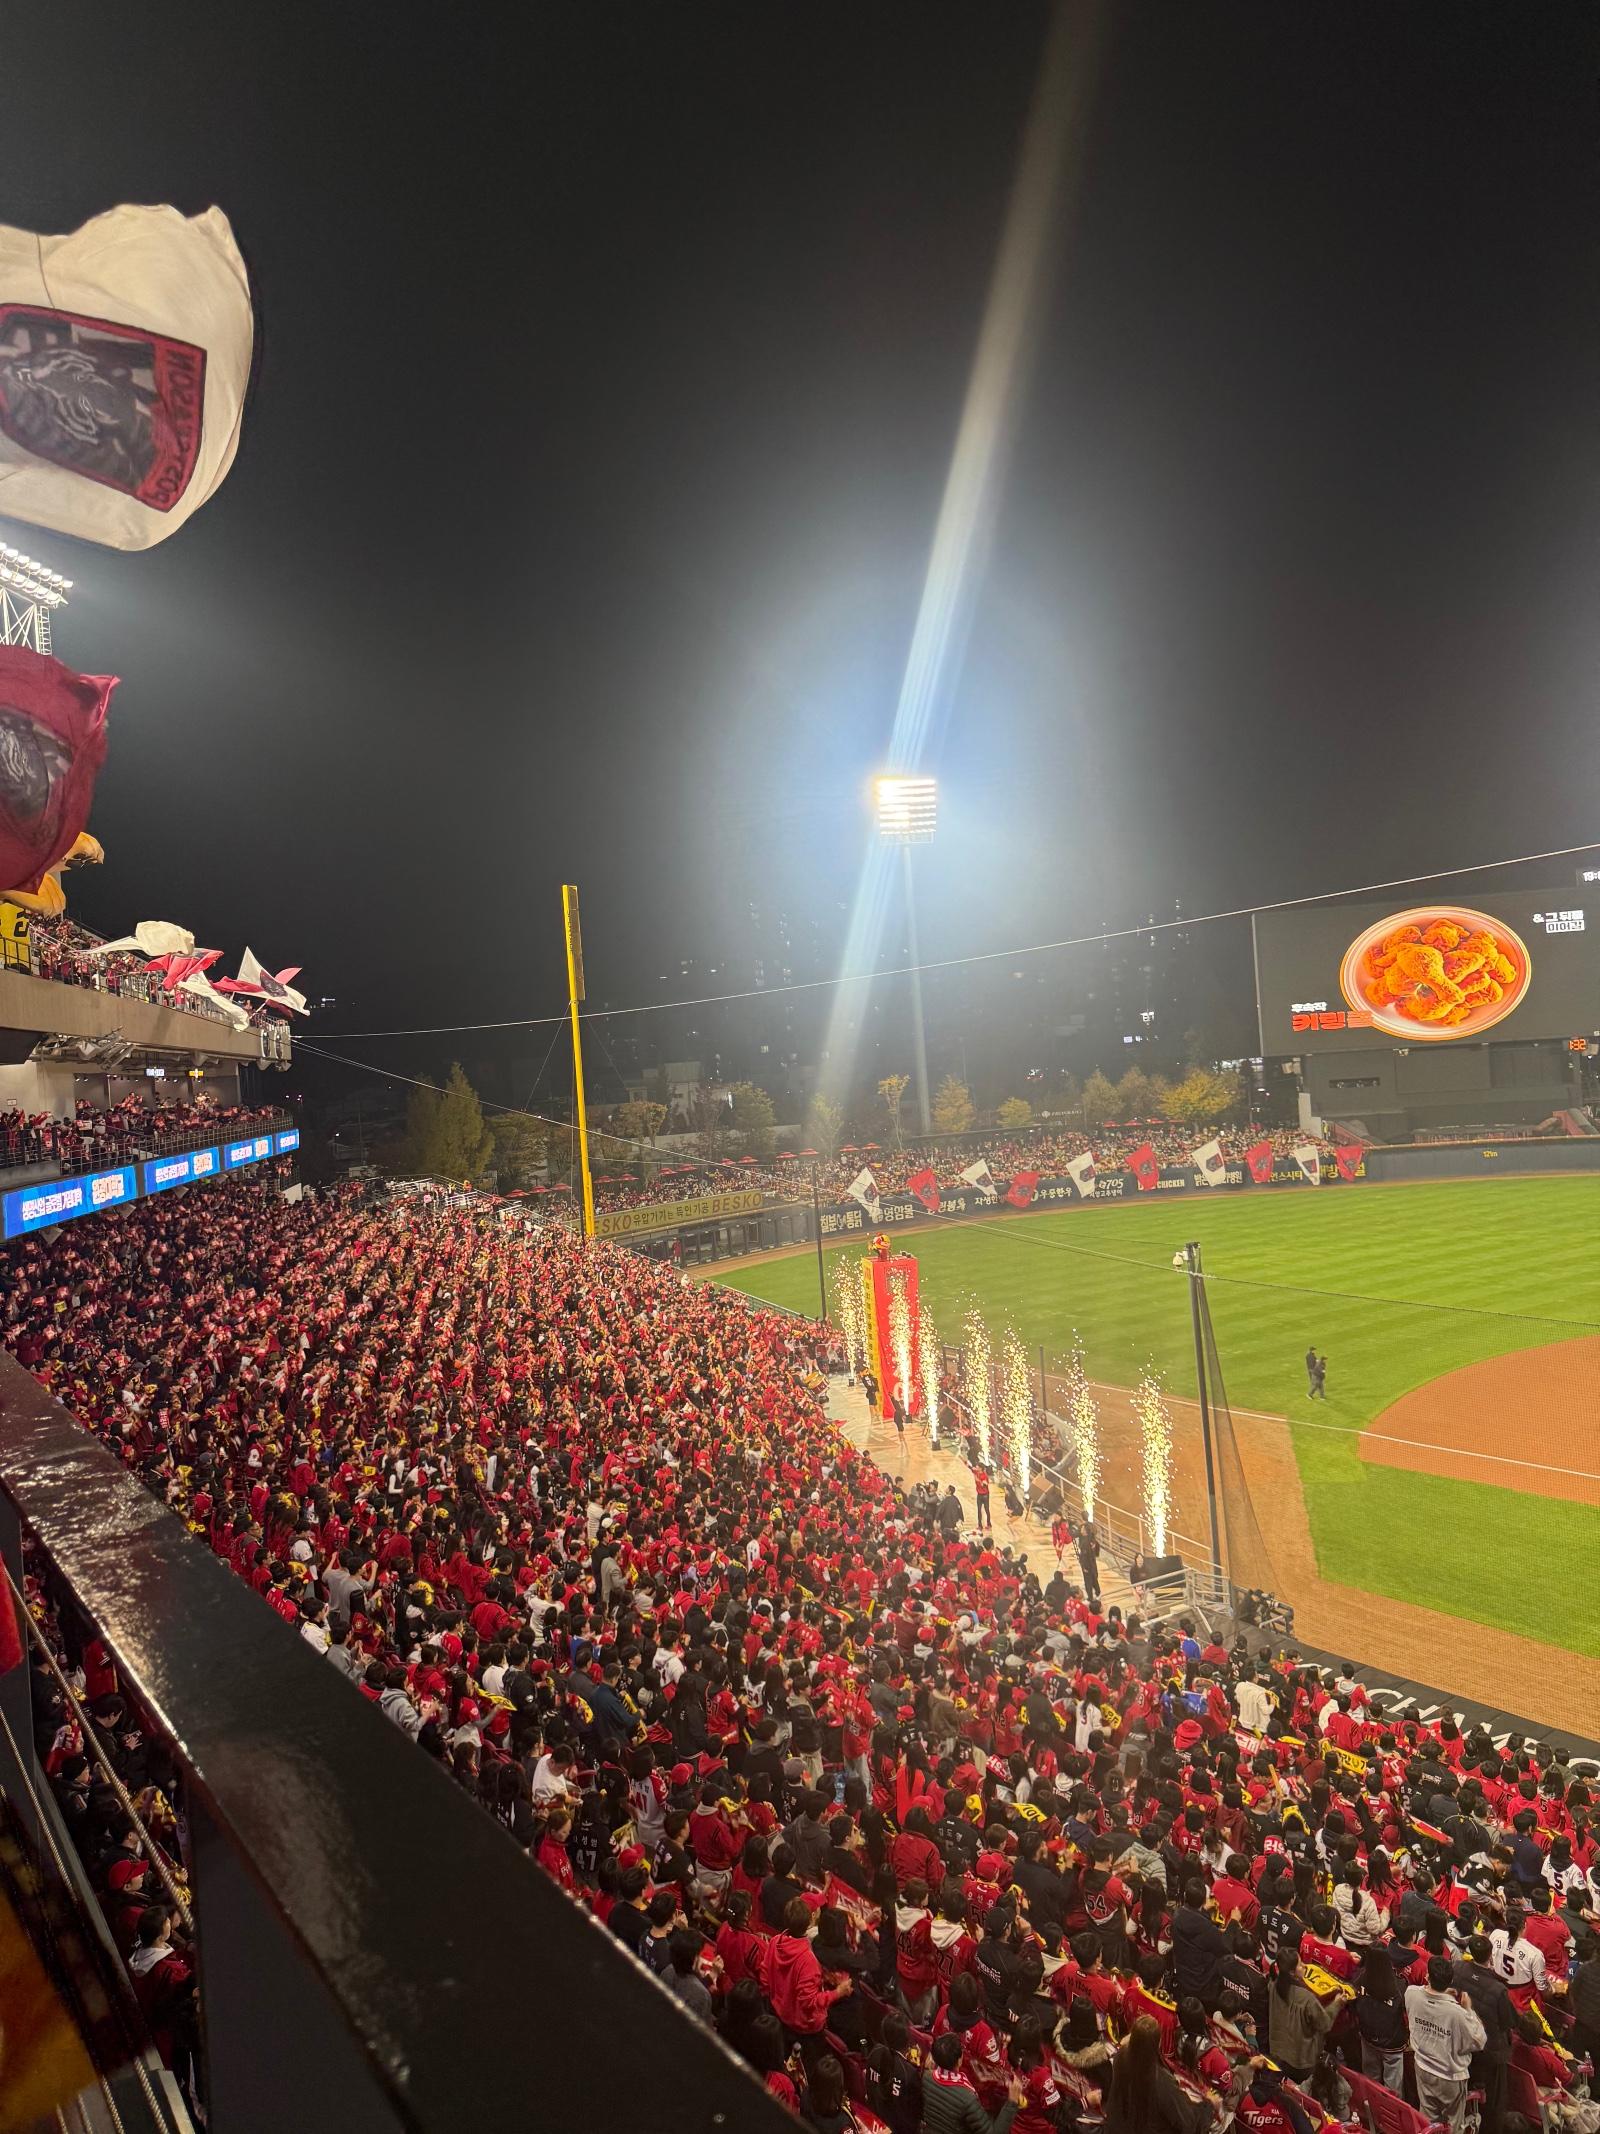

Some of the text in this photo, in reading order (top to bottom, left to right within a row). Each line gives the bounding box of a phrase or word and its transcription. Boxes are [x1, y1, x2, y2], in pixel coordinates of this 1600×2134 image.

[594, 1214, 632, 1235] ESKO
[712, 1192, 762, 1213] BESKO
[1553, 1871, 1564, 1890] 5
[1267, 1930, 1279, 1953] 5
[1502, 1954, 1515, 1977] 5
[1223, 1976, 1250, 2001] TIGERS
[1414, 2017, 1452, 2037] ESSENTIALS
[1243, 2109, 1284, 2127] Tigers
